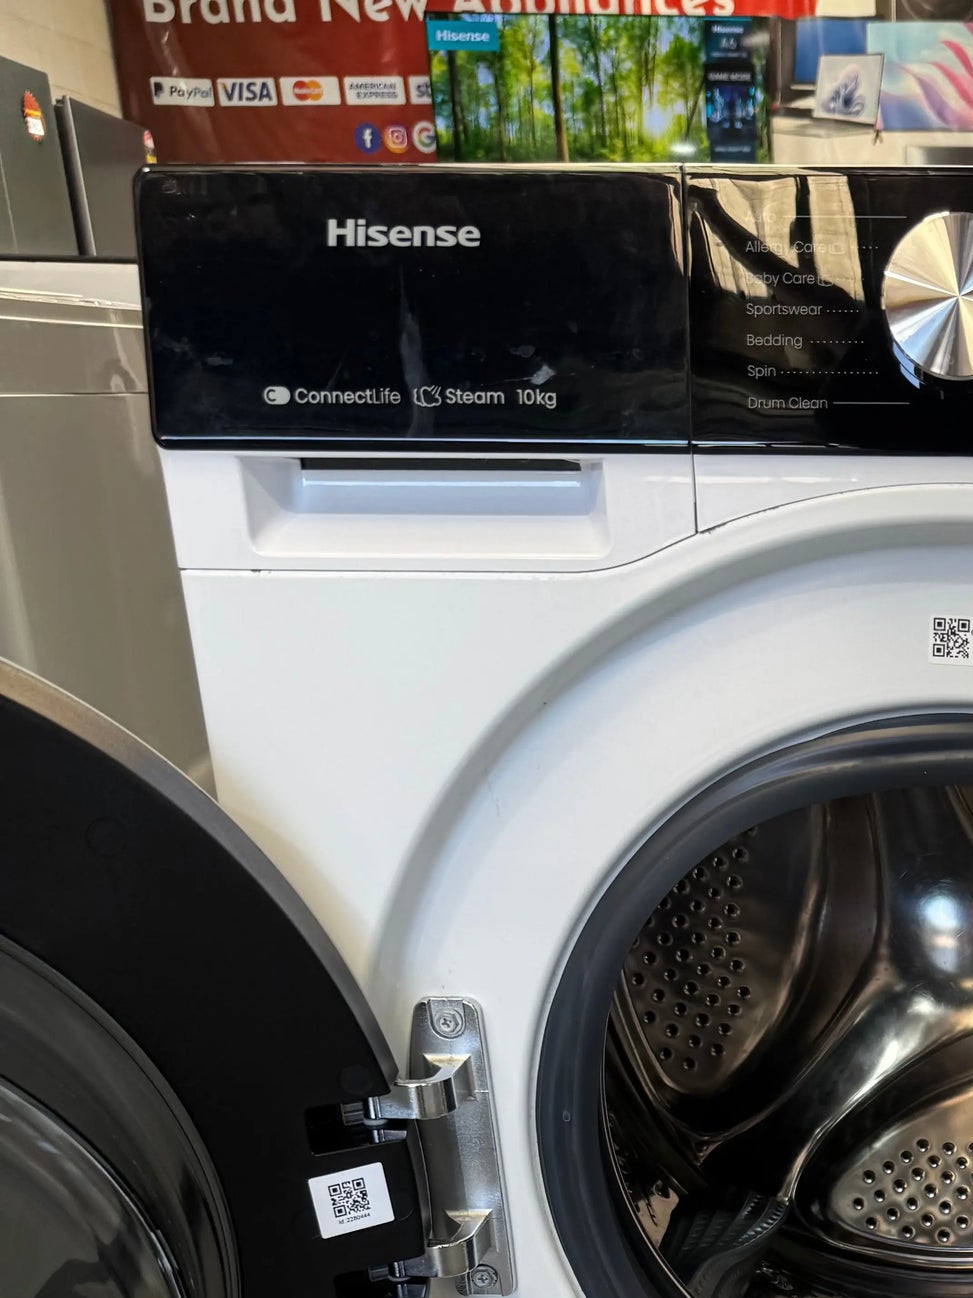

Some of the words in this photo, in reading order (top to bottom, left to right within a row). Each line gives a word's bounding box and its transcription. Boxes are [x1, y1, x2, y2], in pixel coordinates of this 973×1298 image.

[435, 29, 490, 42] Hisense
[169, 86, 212, 99] PayPal
[222, 81, 273, 101] VISA
[326, 218, 481, 247] Hisense
[793, 241, 827, 253] Care
[746, 272, 780, 287] Baby
[782, 272, 815, 284] Care
[746, 303, 822, 318] Sportswear
[746, 334, 803, 349] Bedding
[747, 365, 776, 379] Spin
[295, 388, 401, 404] ConnectLife
[446, 388, 505, 404] Steam
[516, 389, 557, 409] 10kg
[748, 397, 786, 409] Drum
[789, 397, 828, 409] Clean
